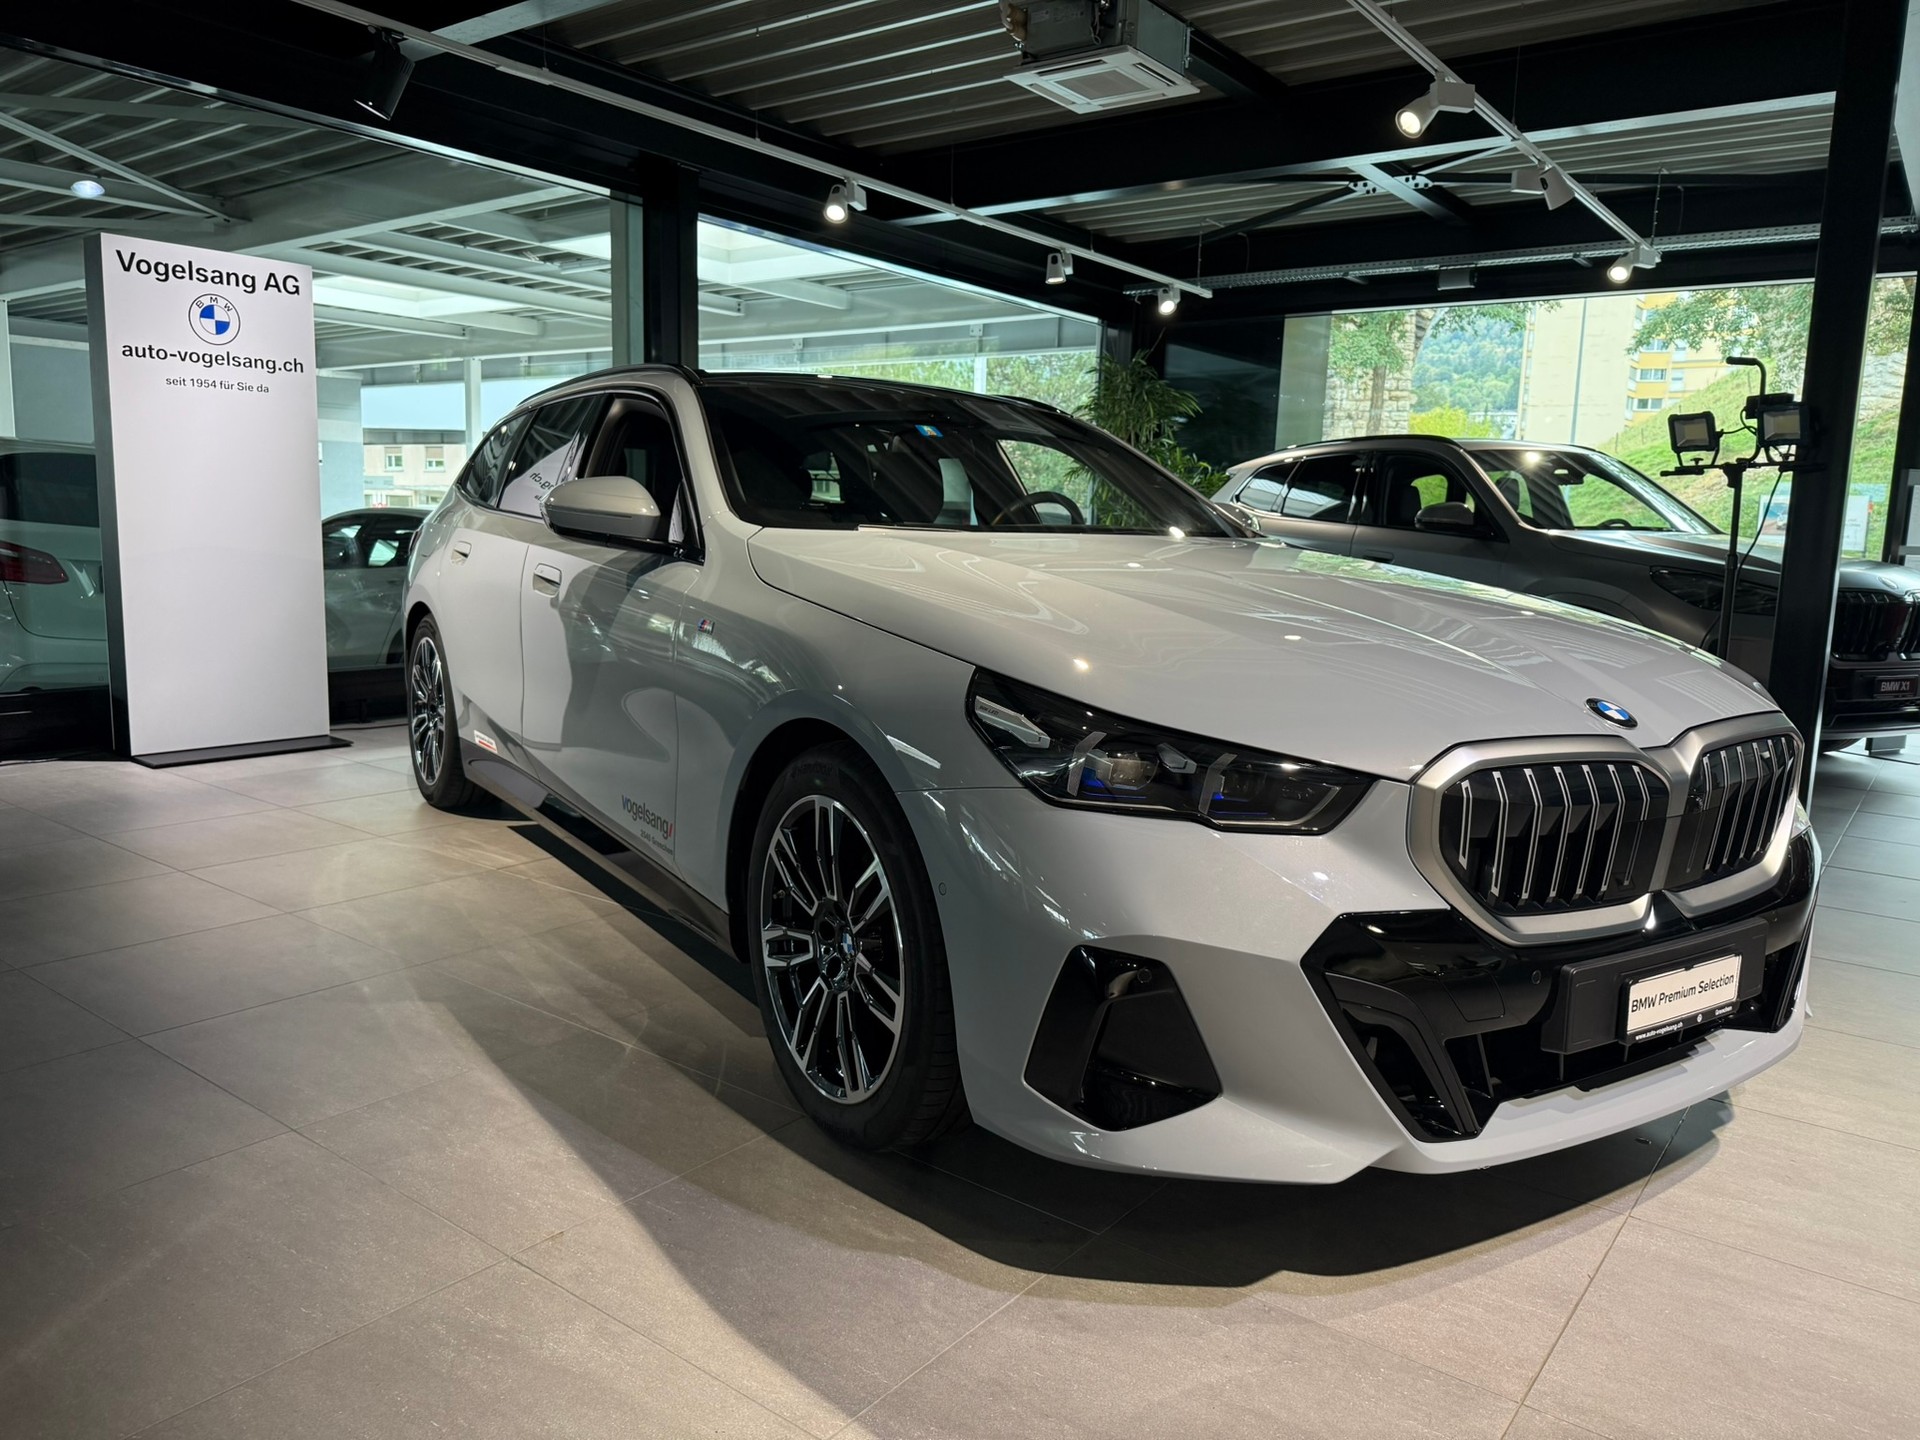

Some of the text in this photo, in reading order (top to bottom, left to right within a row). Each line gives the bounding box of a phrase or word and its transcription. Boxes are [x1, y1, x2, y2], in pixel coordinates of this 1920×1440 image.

[115, 249, 301, 296] Vogelsang AG
[195, 296, 233, 313] BMW
[121, 344, 304, 374] auto-vogelsang.ch
[165, 376, 270, 393] seit 1954 für Sie da
[1880, 681, 1910, 692] BMW X1
[1631, 974, 1734, 1013] BMW Premium Selection
